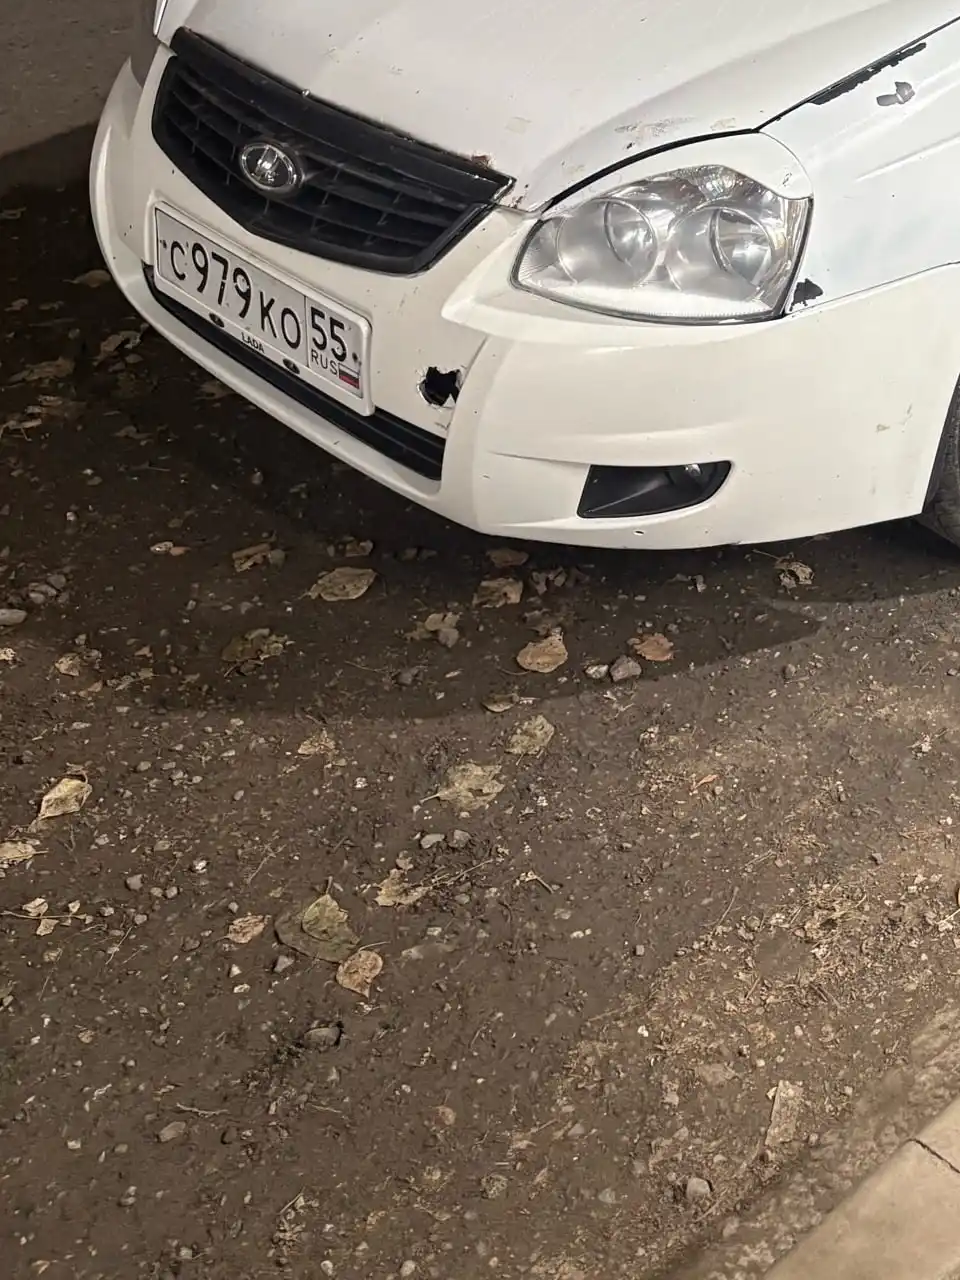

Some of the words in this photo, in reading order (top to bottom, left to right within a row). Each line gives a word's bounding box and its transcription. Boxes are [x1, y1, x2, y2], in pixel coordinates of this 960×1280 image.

[241, 332, 265, 354] LADA
[311, 306, 347, 361] 55
[311, 349, 338, 376] RUS
